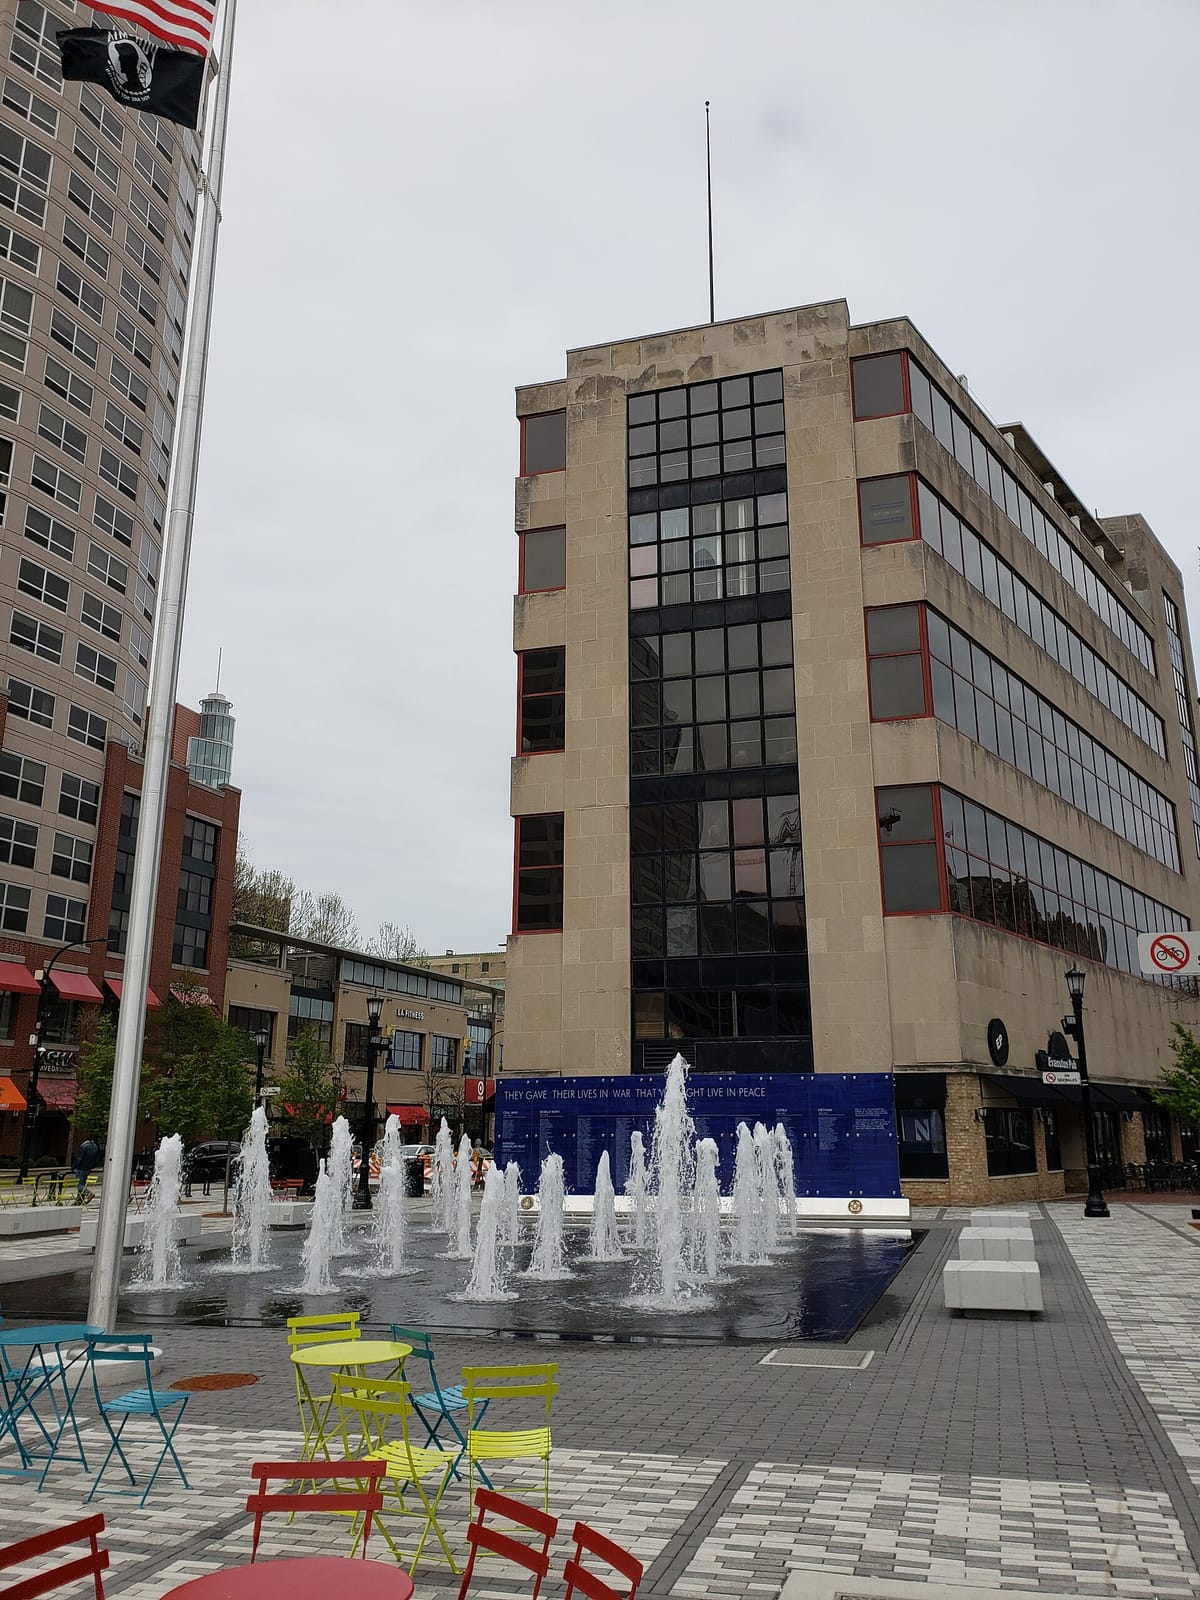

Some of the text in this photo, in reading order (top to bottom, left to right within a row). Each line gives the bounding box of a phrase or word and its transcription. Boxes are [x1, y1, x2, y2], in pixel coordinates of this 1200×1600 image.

[398, 1009, 424, 1020] LA FITNESS
[995, 1033, 1003, 1050] EP
[1048, 1056, 1078, 1070] Evanston Pub
[504, 1091, 524, 1100] THEY
[525, 1090, 547, 1100] GAVE
[552, 1089, 576, 1099] THEIR
[577, 1089, 598, 1099] LIVES
[600, 1088, 609, 1098] IN
[613, 1088, 631, 1098] WAR
[635, 1088, 657, 1098] THAT
[686, 1088, 705, 1097] GHT
[707, 1087, 724, 1097] LIVE
[726, 1087, 736, 1097] IN
[739, 1087, 766, 1097] PEACE
[914, 1119, 931, 1141] N
